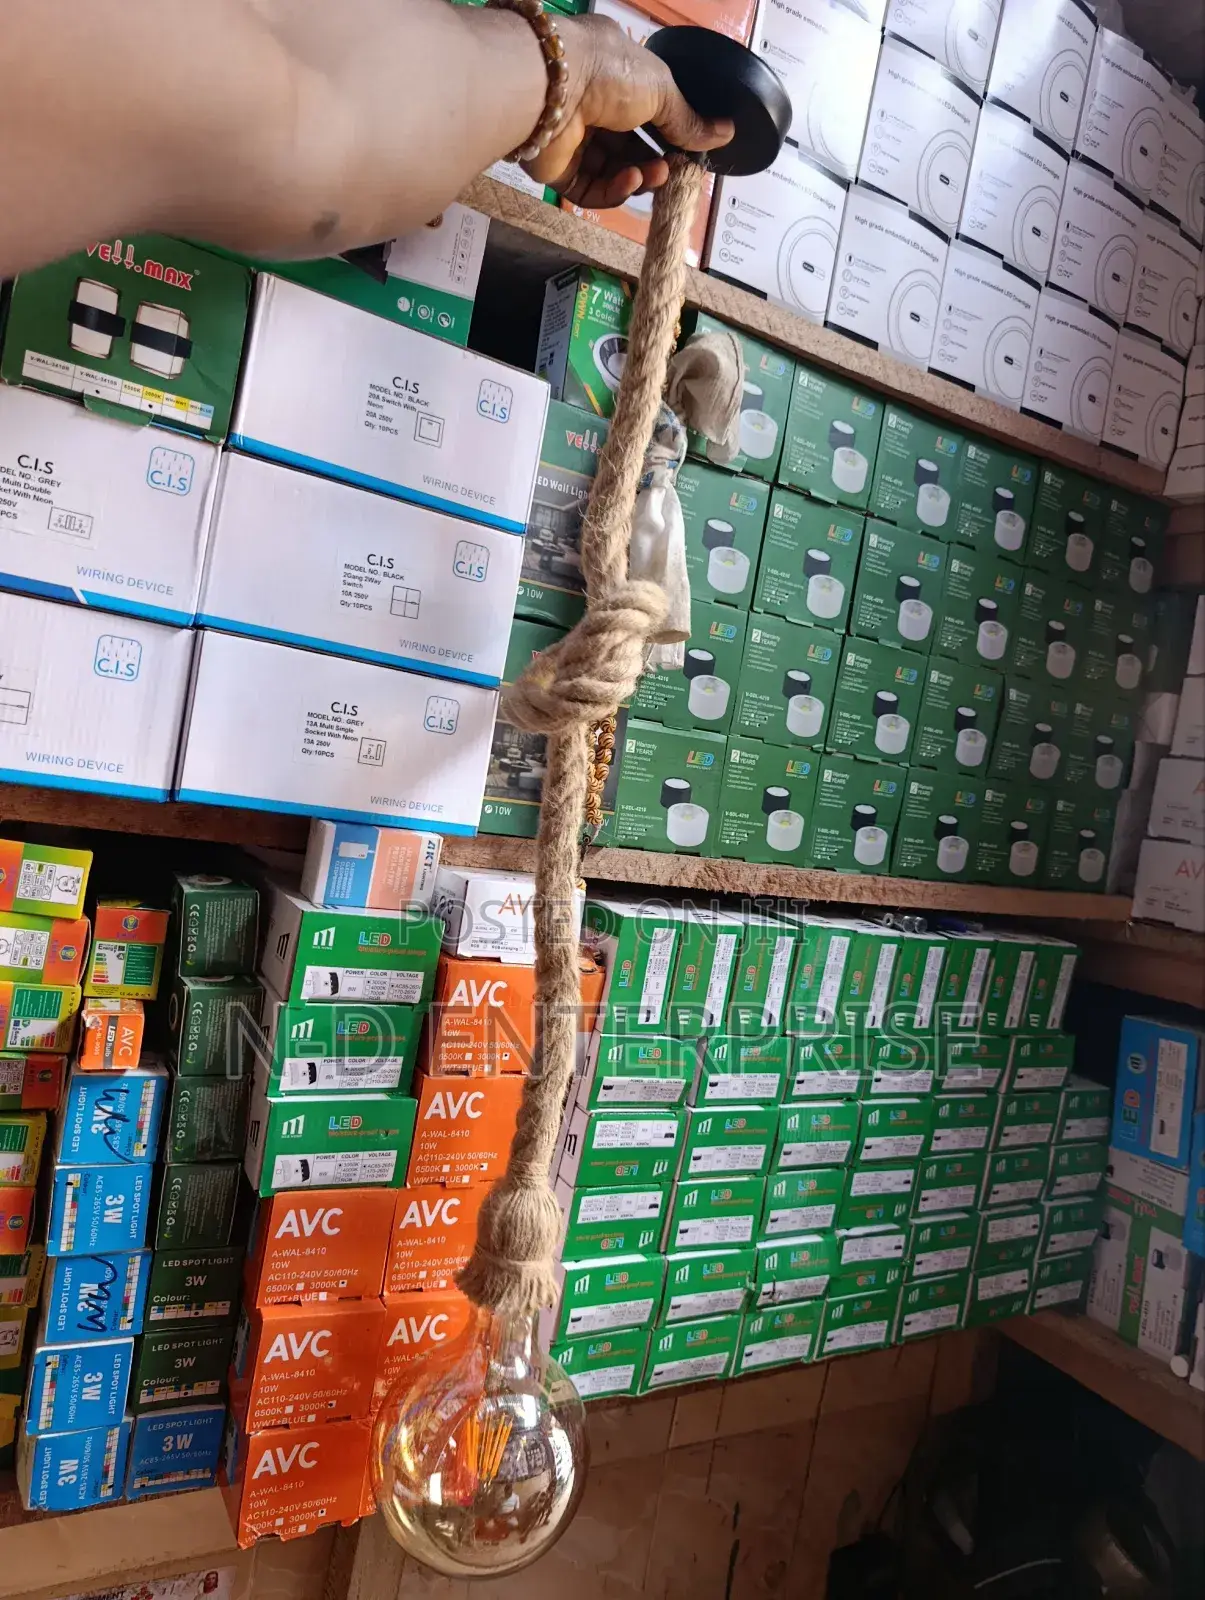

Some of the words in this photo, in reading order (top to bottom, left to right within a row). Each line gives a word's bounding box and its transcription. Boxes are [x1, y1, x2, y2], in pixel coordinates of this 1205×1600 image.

[586, 210, 601, 223] 9W
[854, 214, 868, 226] High
[868, 220, 884, 232] grade
[954, 267, 967, 277] High
[591, 285, 602, 305] 7
[603, 289, 624, 307] Watt
[392, 376, 420, 394] C.I.S
[369, 383, 392, 396] MODEL
[407, 395, 430, 408] BLACK
[479, 399, 508, 420] C.I.S
[17, 453, 54, 475] C.I.S
[23, 482, 52, 496] Double
[37, 476, 62, 489] GREY
[150, 470, 188, 492] C.I.S
[537, 475, 549, 488] ED
[549, 478, 570, 495] Wall
[571, 487, 591, 502] Ligh
[13, 488, 31, 501] With
[32, 492, 54, 506] Neon
[422, 474, 459, 494] WIRING
[461, 486, 497, 506] DEVICE
[367, 553, 395, 569] C.I.S
[455, 560, 484, 579] C.I.S
[76, 565, 125, 585] WIRING
[127, 577, 174, 597] DEVICE
[383, 571, 405, 581] BLACK
[526, 587, 544, 600] 10W
[709, 621, 737, 639] LED
[399, 639, 436, 656] WIRING
[438, 647, 475, 664] DEVICE
[97, 657, 136, 678] C.I.S
[330, 701, 359, 717] C.I.S
[307, 711, 331, 722] MODEL
[346, 718, 365, 728] GREY
[426, 715, 454, 732] C.I.S
[304, 727, 327, 738] Socket
[636, 748, 654, 756] YEARS
[686, 750, 714, 767] LED
[25, 751, 74, 767] WIRING
[77, 758, 124, 774] DEVICE
[739, 757, 756, 766] YEARS
[785, 759, 811, 775] LED
[370, 795, 407, 810] WIRING
[408, 801, 444, 814] DEVICE
[494, 805, 512, 816] 10W
[498, 892, 534, 916] AV
[358, 930, 392, 947] LED
[619, 959, 632, 988] LED
[683, 964, 696, 991] LED
[448, 979, 508, 1008] AVC
[337, 1021, 370, 1034] LED
[444, 1017, 493, 1027] A-WAL-8410
[107, 1025, 116, 1042] LED
[119, 1026, 135, 1056] AVC
[443, 1029, 460, 1038] 10W
[105, 1042, 113, 1057] Bulb
[77, 1086, 88, 1110] LIGHT
[424, 1091, 485, 1120] AVC
[74, 1111, 84, 1134] SPOT
[329, 1115, 363, 1130] LED
[421, 1129, 470, 1139] A-WAL-8410
[71, 1135, 80, 1152] LED
[420, 1142, 437, 1150] 10W
[417, 1152, 465, 1162] AC110-240V
[467, 1151, 498, 1161] 50/60Hz
[415, 1164, 441, 1173] 6500K
[454, 1162, 479, 1172] 3000K
[135, 1175, 143, 1190] LED
[413, 1174, 461, 1185] WWT+BLUE
[104, 1194, 125, 1224] 3W
[132, 1191, 142, 1216] SPOT
[399, 1197, 461, 1229] AVC
[130, 1216, 140, 1239] LIGHT
[275, 1207, 344, 1239] AVC
[397, 1236, 446, 1247] A-WAL-8410
[272, 1246, 327, 1258] A-WAL-8410
[396, 1250, 413, 1259] 10W
[163, 1259, 181, 1268] LED
[182, 1258, 206, 1267] SPOT
[208, 1257, 234, 1266] LIGHT
[271, 1260, 290, 1269] 10W
[185, 1275, 207, 1287] 3W
[268, 1269, 322, 1282] AC110-240V
[323, 1268, 358, 1277] 50/60Hz
[605, 1272, 629, 1286] LED
[266, 1283, 294, 1293] 6500K
[310, 1280, 337, 1290] 3000K
[153, 1293, 190, 1303] Colour:
[264, 1292, 318, 1304] WWT+BLUE
[387, 1314, 449, 1347] AVC
[152, 1343, 170, 1352] LED
[171, 1341, 195, 1351] SPOT
[197, 1338, 223, 1347] LIGHT
[264, 1330, 332, 1363] AVC
[175, 1357, 196, 1369] 3W
[260, 1369, 315, 1382] A-WAL-8410
[82, 1372, 104, 1401] 3W
[259, 1384, 279, 1394] 10W
[256, 1392, 311, 1406] AC110-240V
[312, 1388, 347, 1399] 50/60Hz
[254, 1406, 283, 1417] 6500K
[299, 1402, 327, 1413] 3000K
[148, 1422, 164, 1432] LED
[165, 1420, 187, 1429] SPOT
[188, 1417, 214, 1427] LIGHT
[252, 1442, 320, 1479] AVC
[58, 1459, 78, 1486] 3W
[250, 1480, 304, 1498] A-WAL-8410
[246, 1503, 301, 1521] AC110-240V
[303, 1496, 337, 1510] 50/60Hz
[249, 1498, 268, 1508] 10W
[289, 1511, 316, 1523] 3000K
